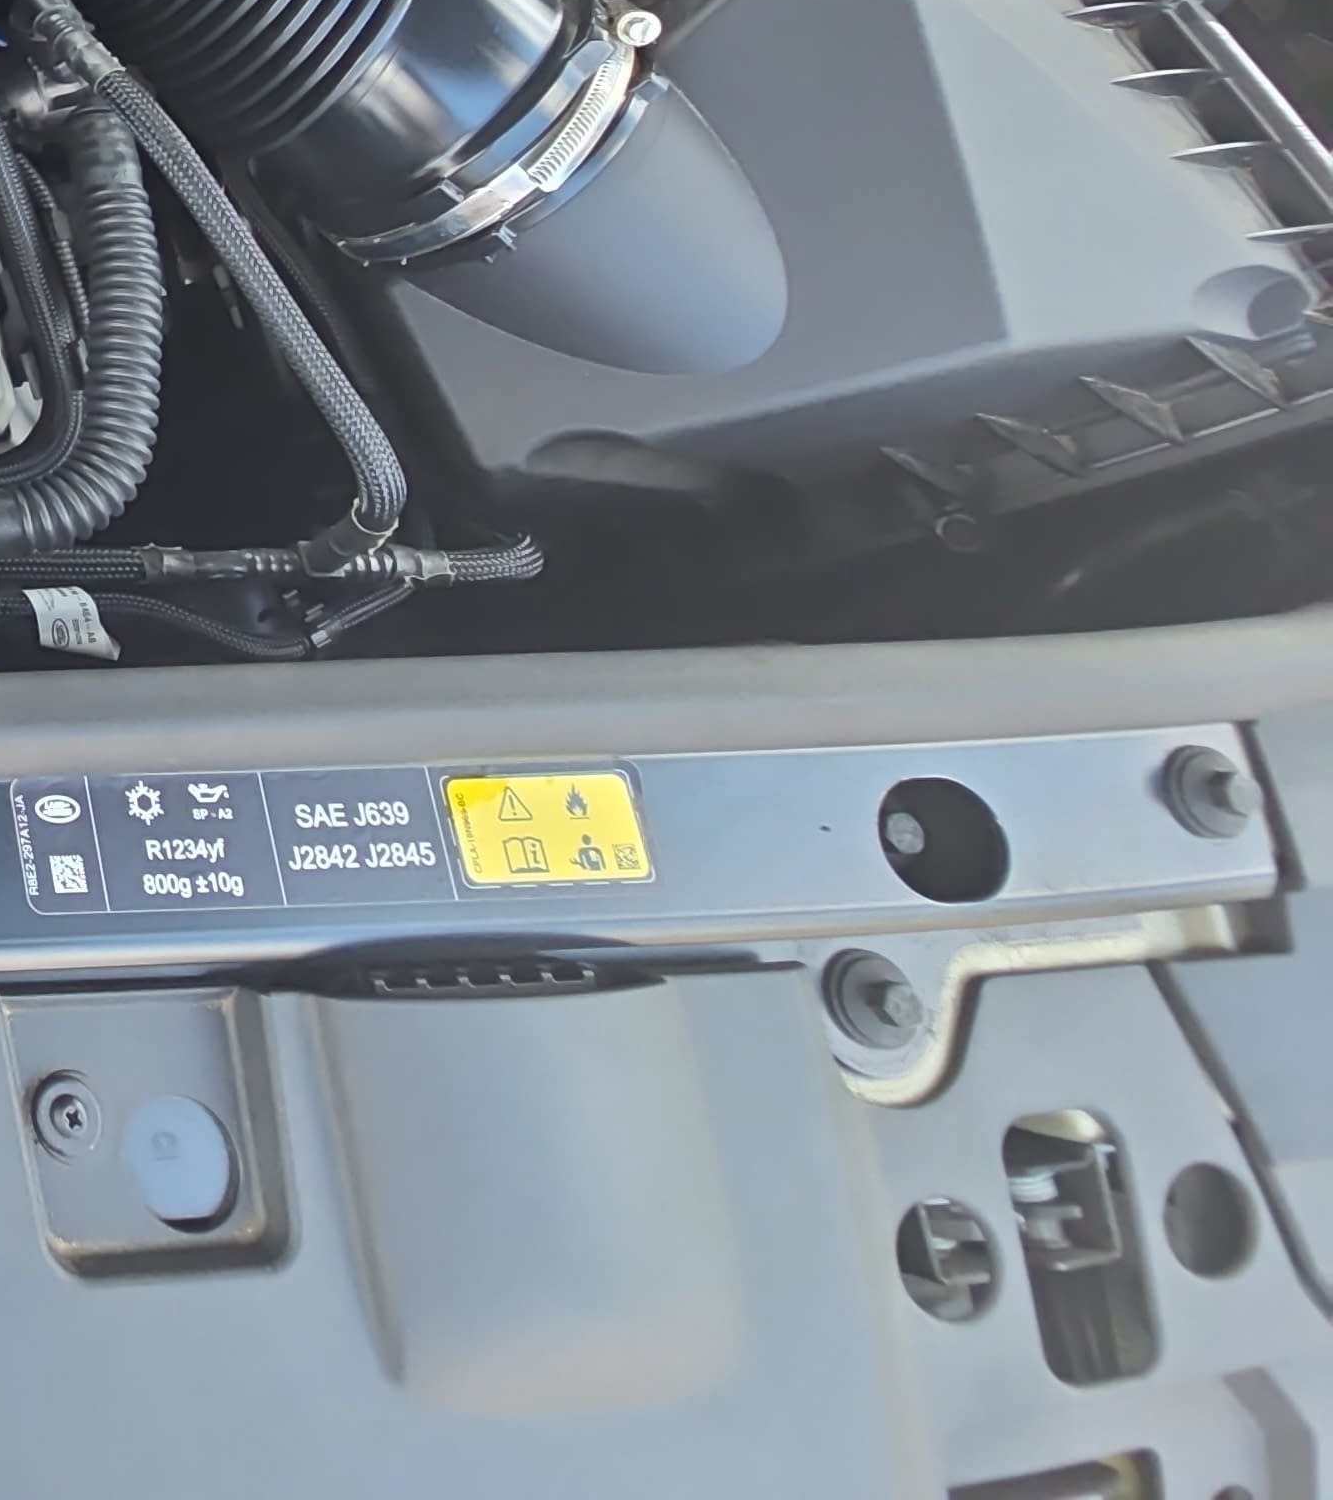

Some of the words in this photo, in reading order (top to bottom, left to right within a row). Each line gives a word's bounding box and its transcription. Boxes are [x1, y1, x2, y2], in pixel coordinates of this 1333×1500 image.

[295, 803, 350, 828] SAE
[353, 801, 410, 827] J639
[144, 838, 226, 863] R1234yf
[288, 844, 361, 871] J2842
[364, 841, 437, 868] J2845
[142, 873, 192, 899] 800g
[195, 871, 245, 897] ±10g
